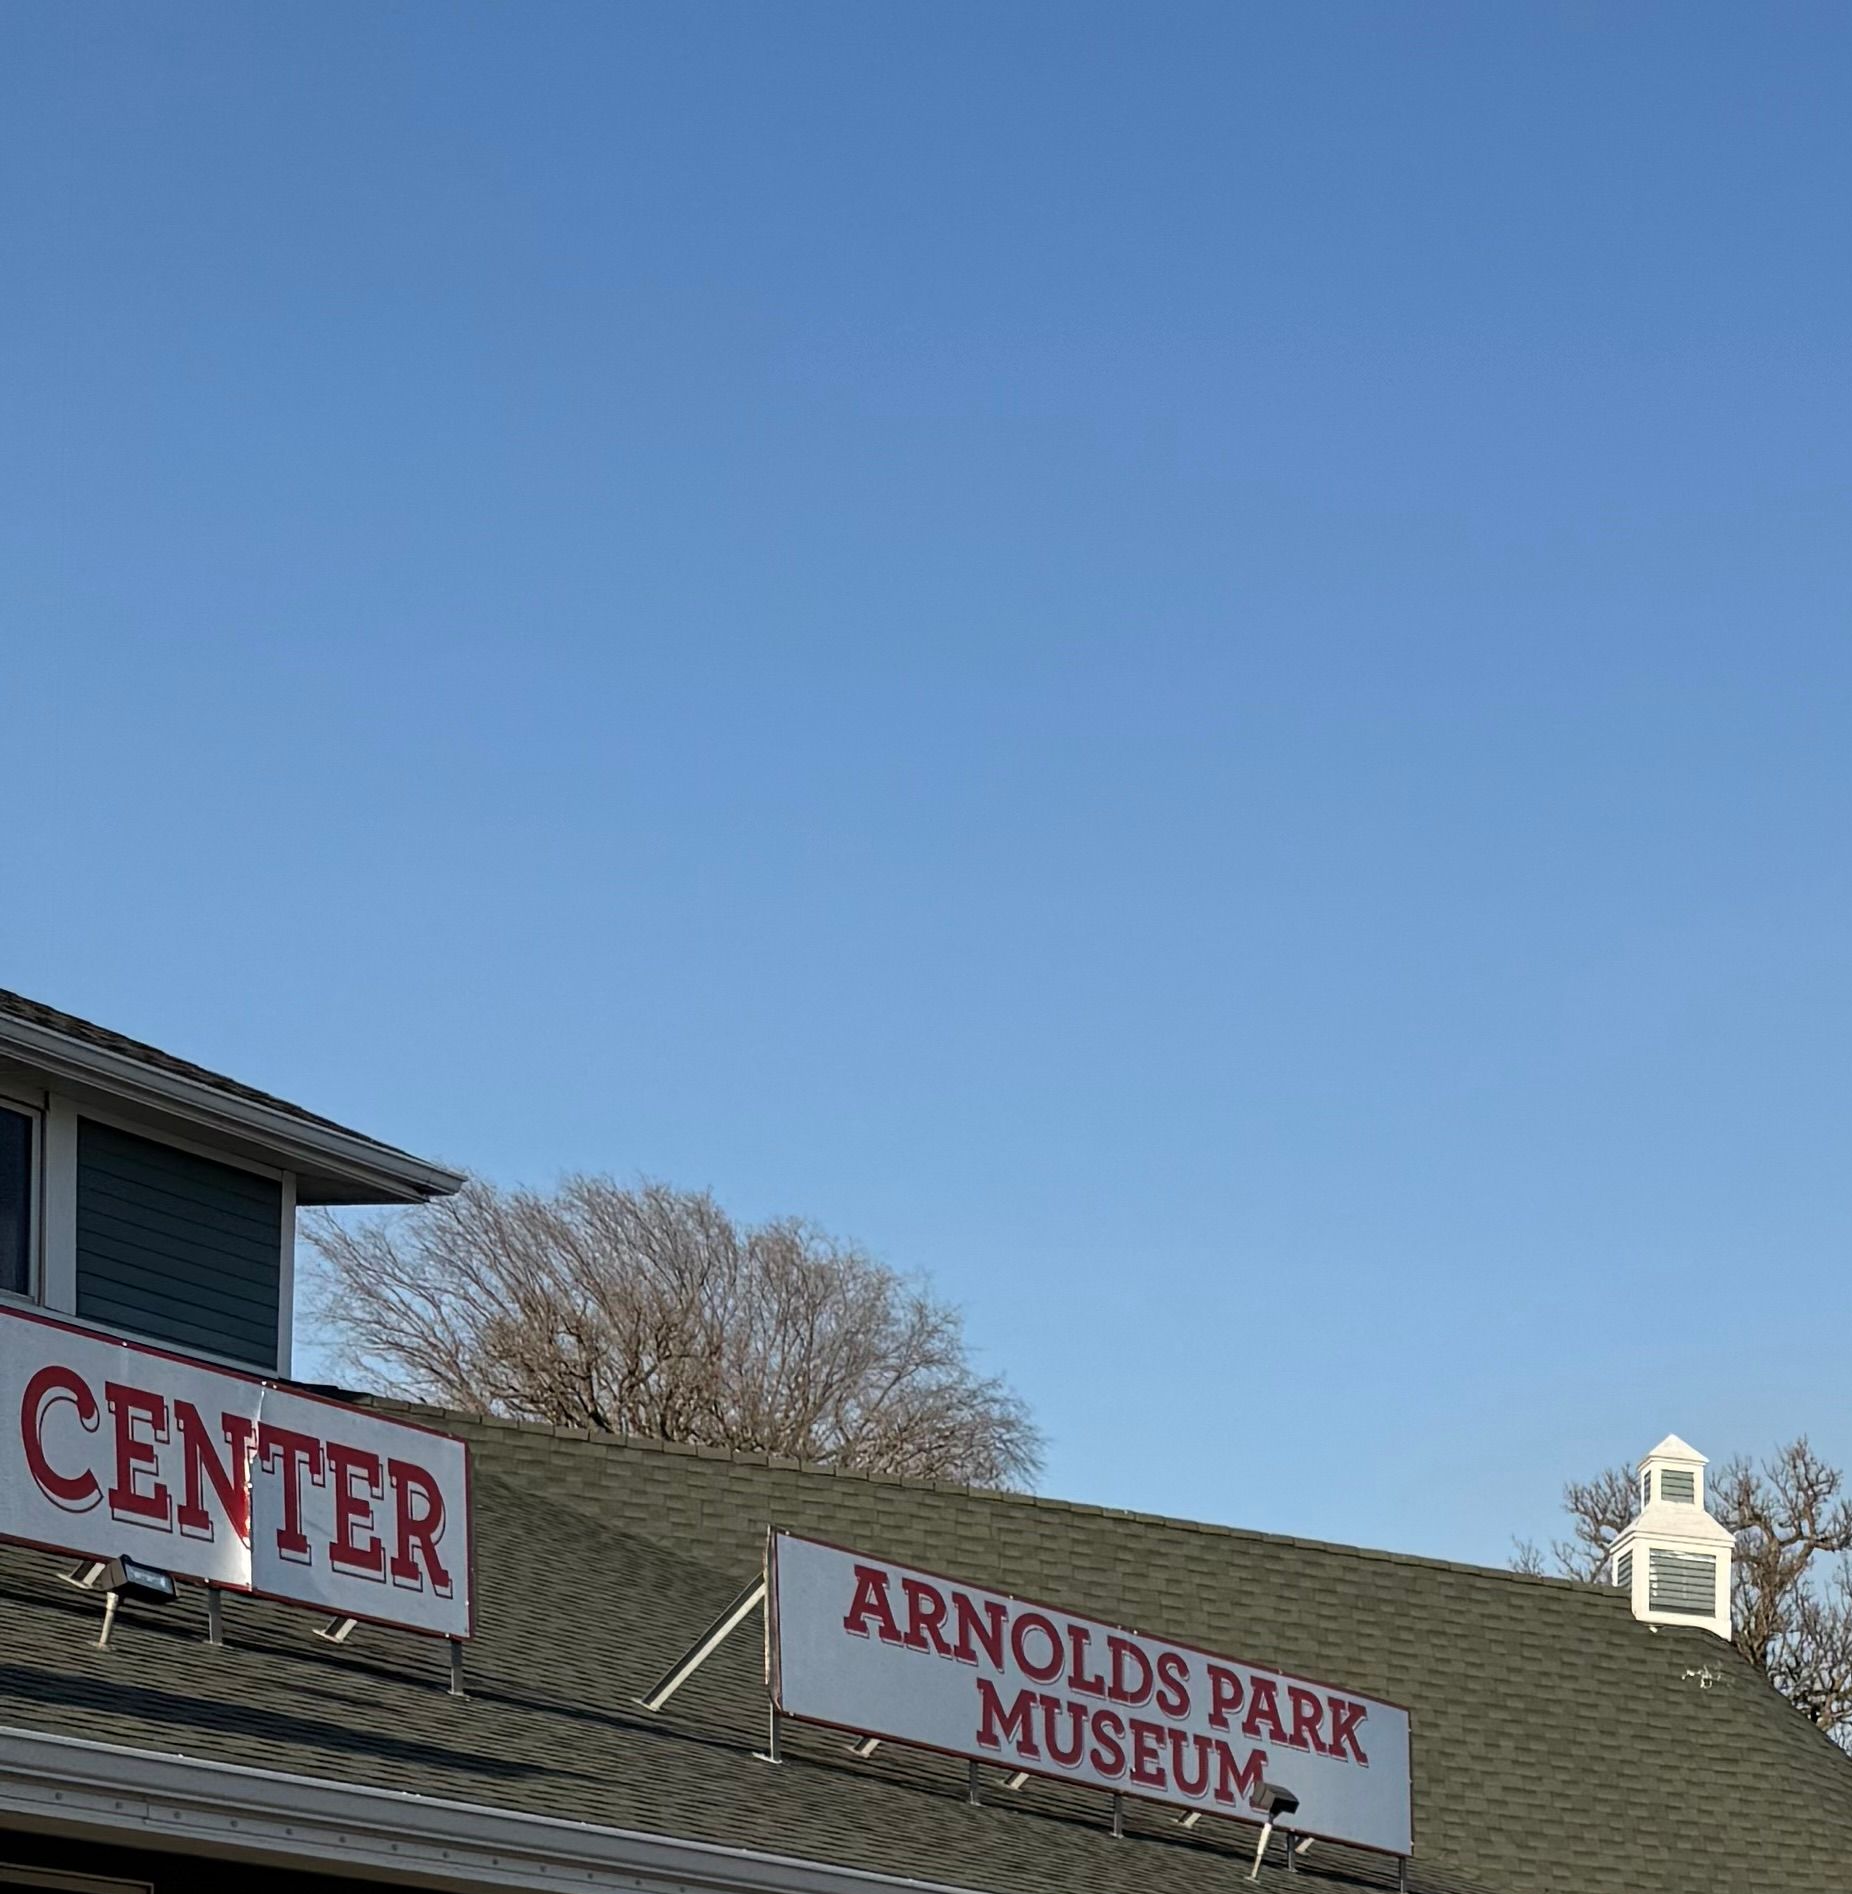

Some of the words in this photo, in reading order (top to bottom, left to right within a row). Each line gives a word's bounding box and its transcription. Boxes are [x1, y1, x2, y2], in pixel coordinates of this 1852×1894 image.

[21, 1366, 453, 1598] CENTER
[843, 1563, 1192, 1721] ARNOLDS
[1206, 1663, 1369, 1767] PARK
[975, 1677, 1267, 1812] MUSEUM
